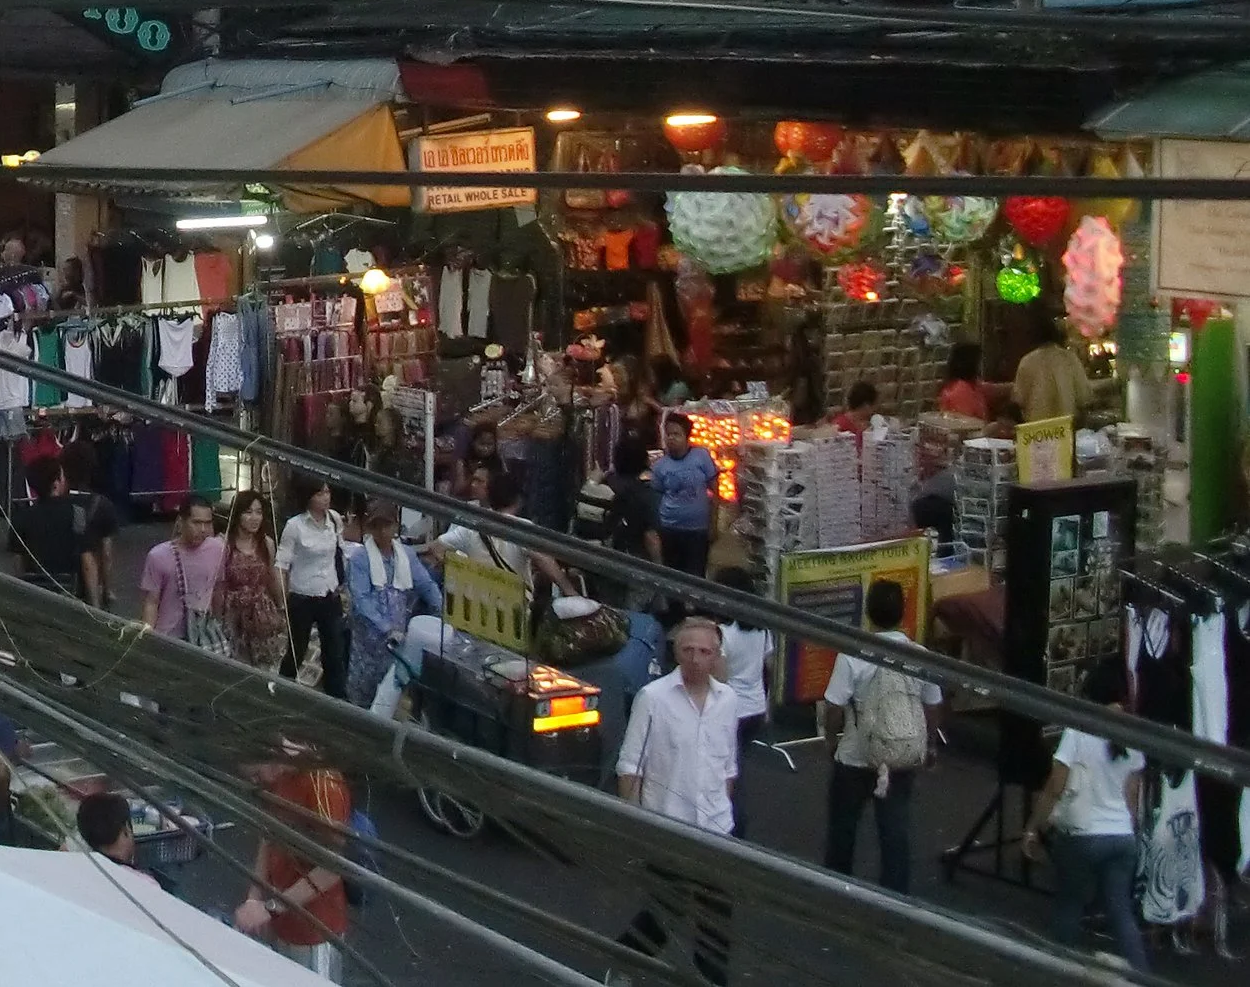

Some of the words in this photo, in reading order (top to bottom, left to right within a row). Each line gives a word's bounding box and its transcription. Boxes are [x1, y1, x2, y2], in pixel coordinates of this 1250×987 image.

[428, 193, 462, 206] RETAIL
[465, 190, 499, 203] WHOLE
[502, 188, 527, 199] SALE
